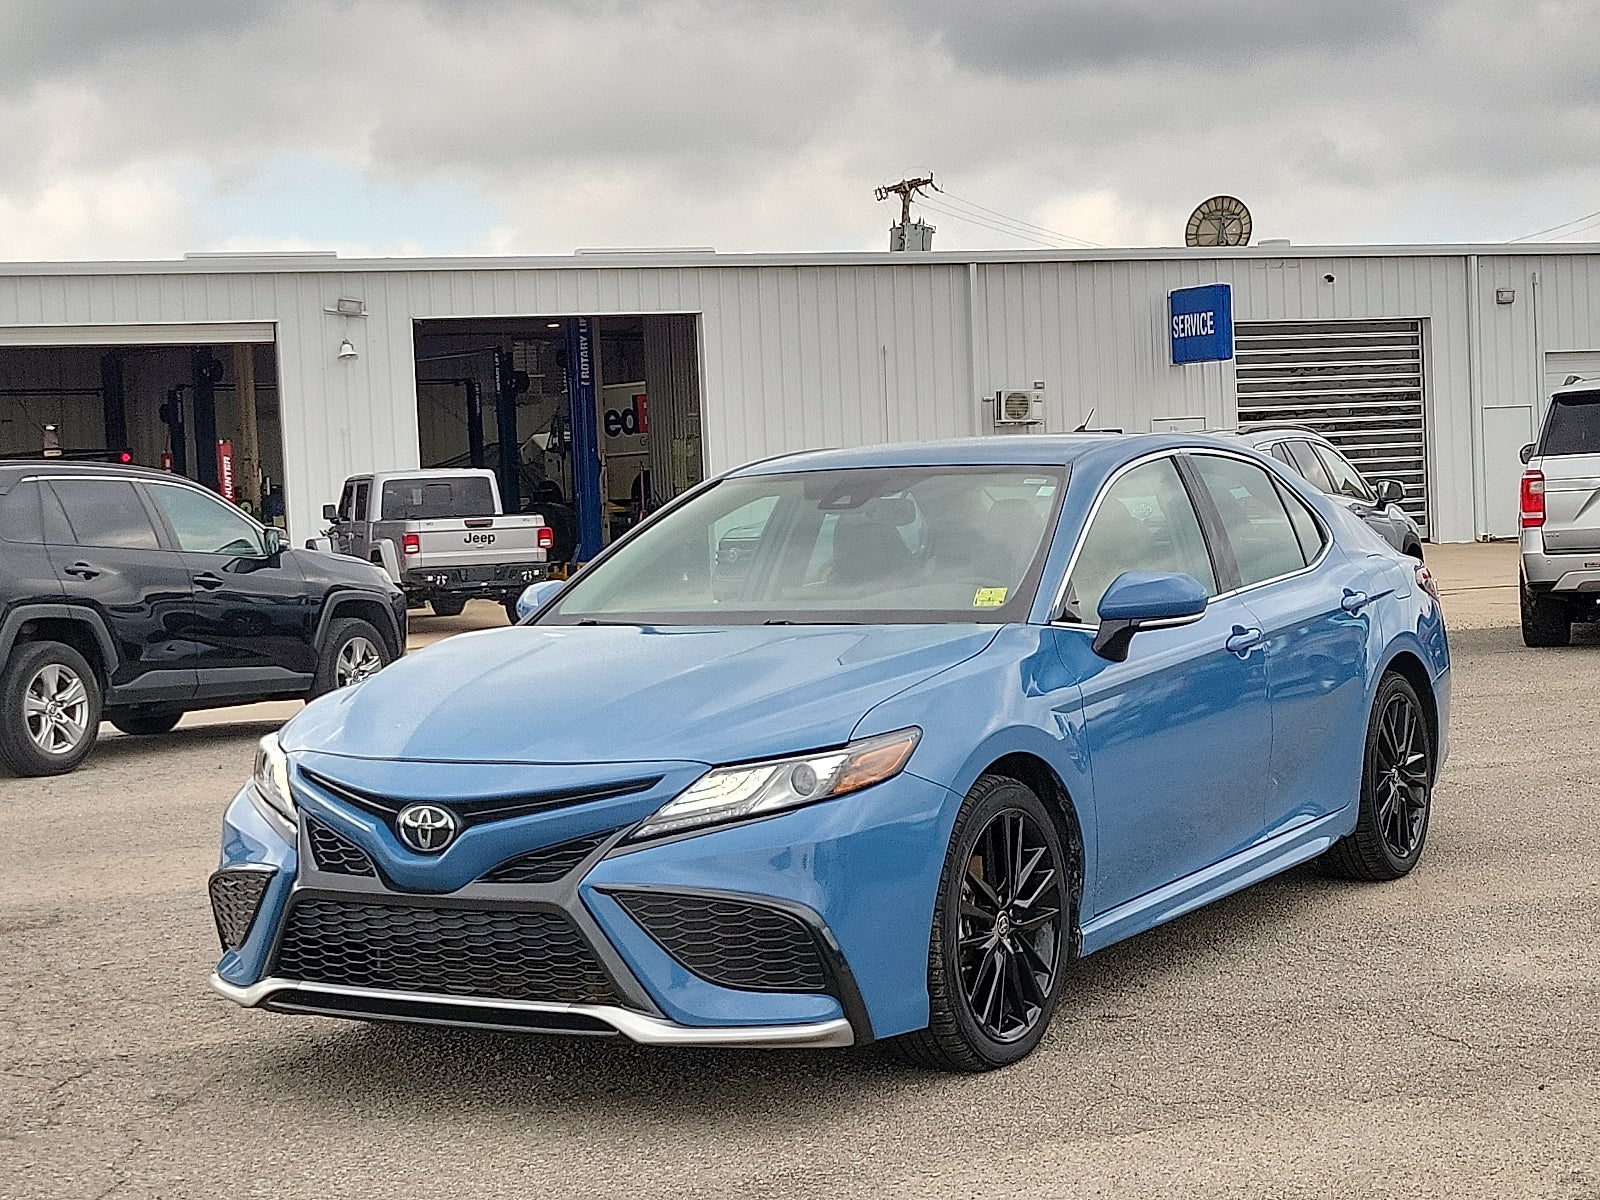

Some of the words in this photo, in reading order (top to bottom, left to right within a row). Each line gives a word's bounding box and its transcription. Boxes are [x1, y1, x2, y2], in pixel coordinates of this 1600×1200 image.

[1173, 311, 1215, 338] SERVICE
[580, 335, 590, 379] ROTARY
[223, 456, 233, 499] HUNTER
[464, 532, 495, 545] Jeep
